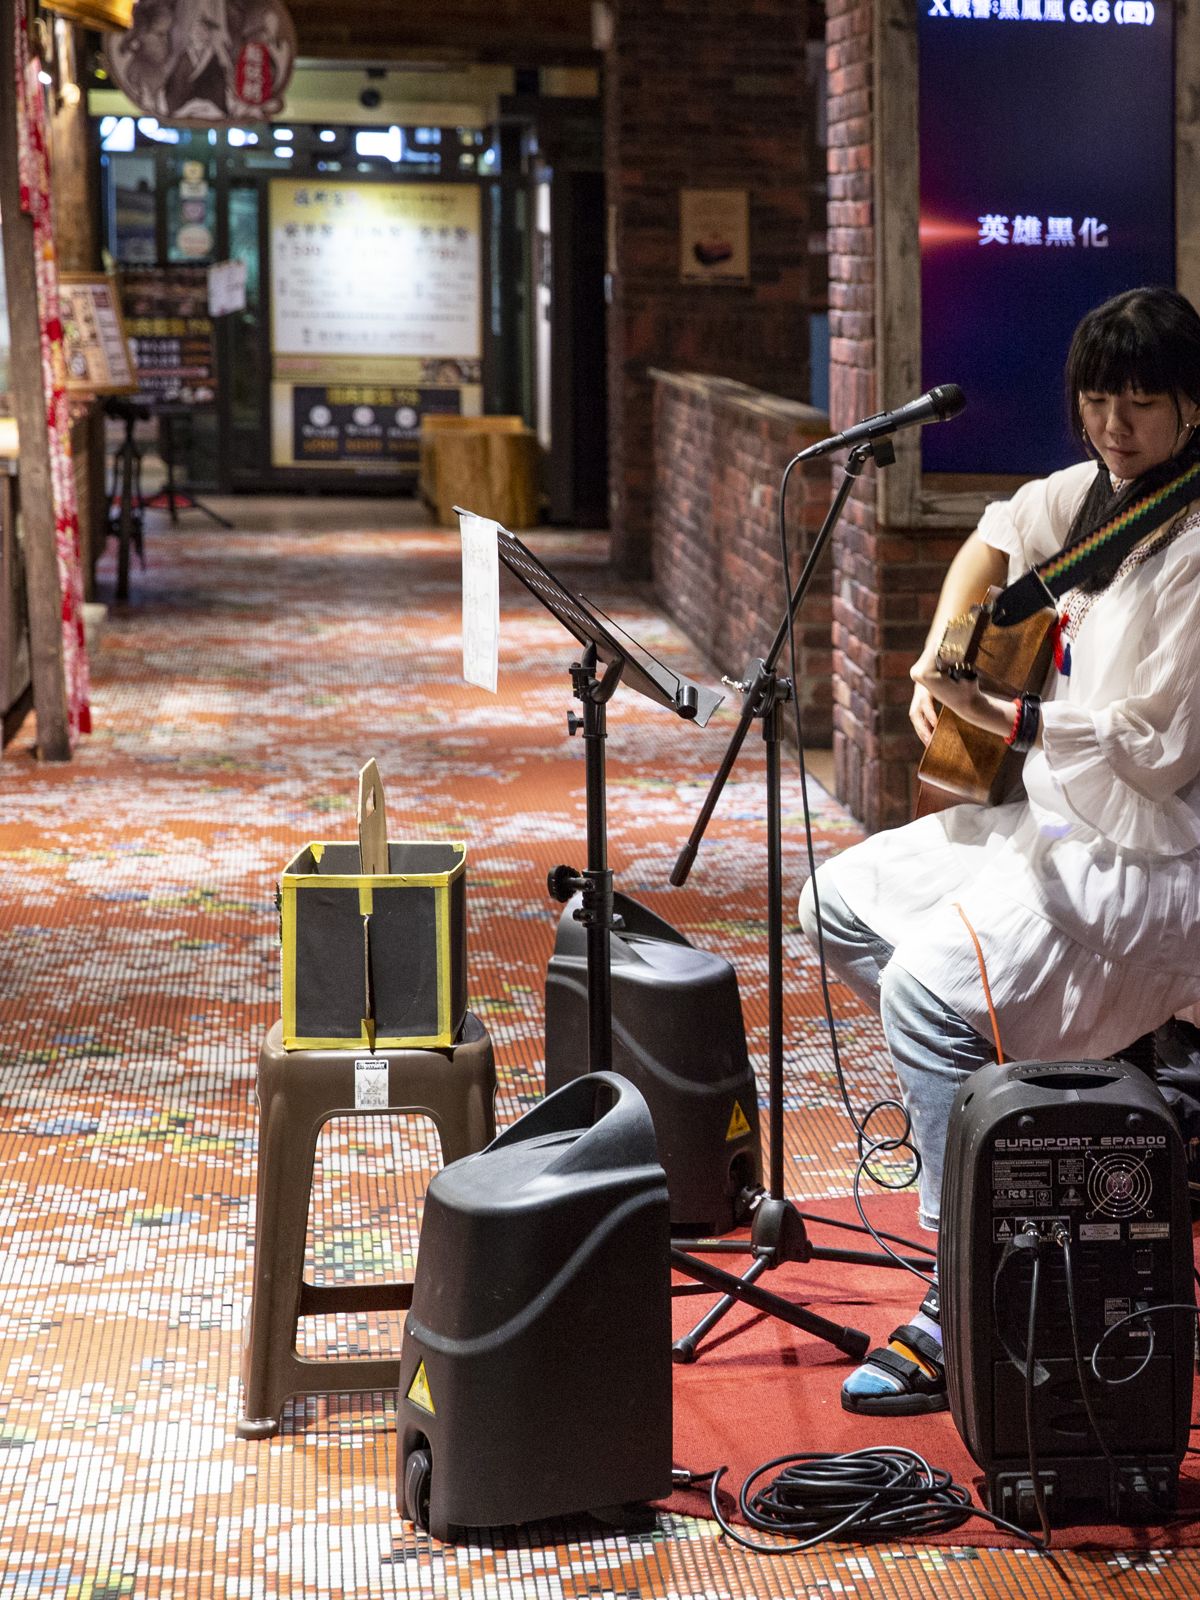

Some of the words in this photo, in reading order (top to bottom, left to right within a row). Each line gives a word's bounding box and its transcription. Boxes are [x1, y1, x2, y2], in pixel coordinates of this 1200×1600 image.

[1069, 0, 1110, 23] 6.6
[978, 214, 1109, 247] 英雄黑化
[994, 1136, 1093, 1148] EUROPORT
[1100, 1135, 1166, 1146] EPA300
